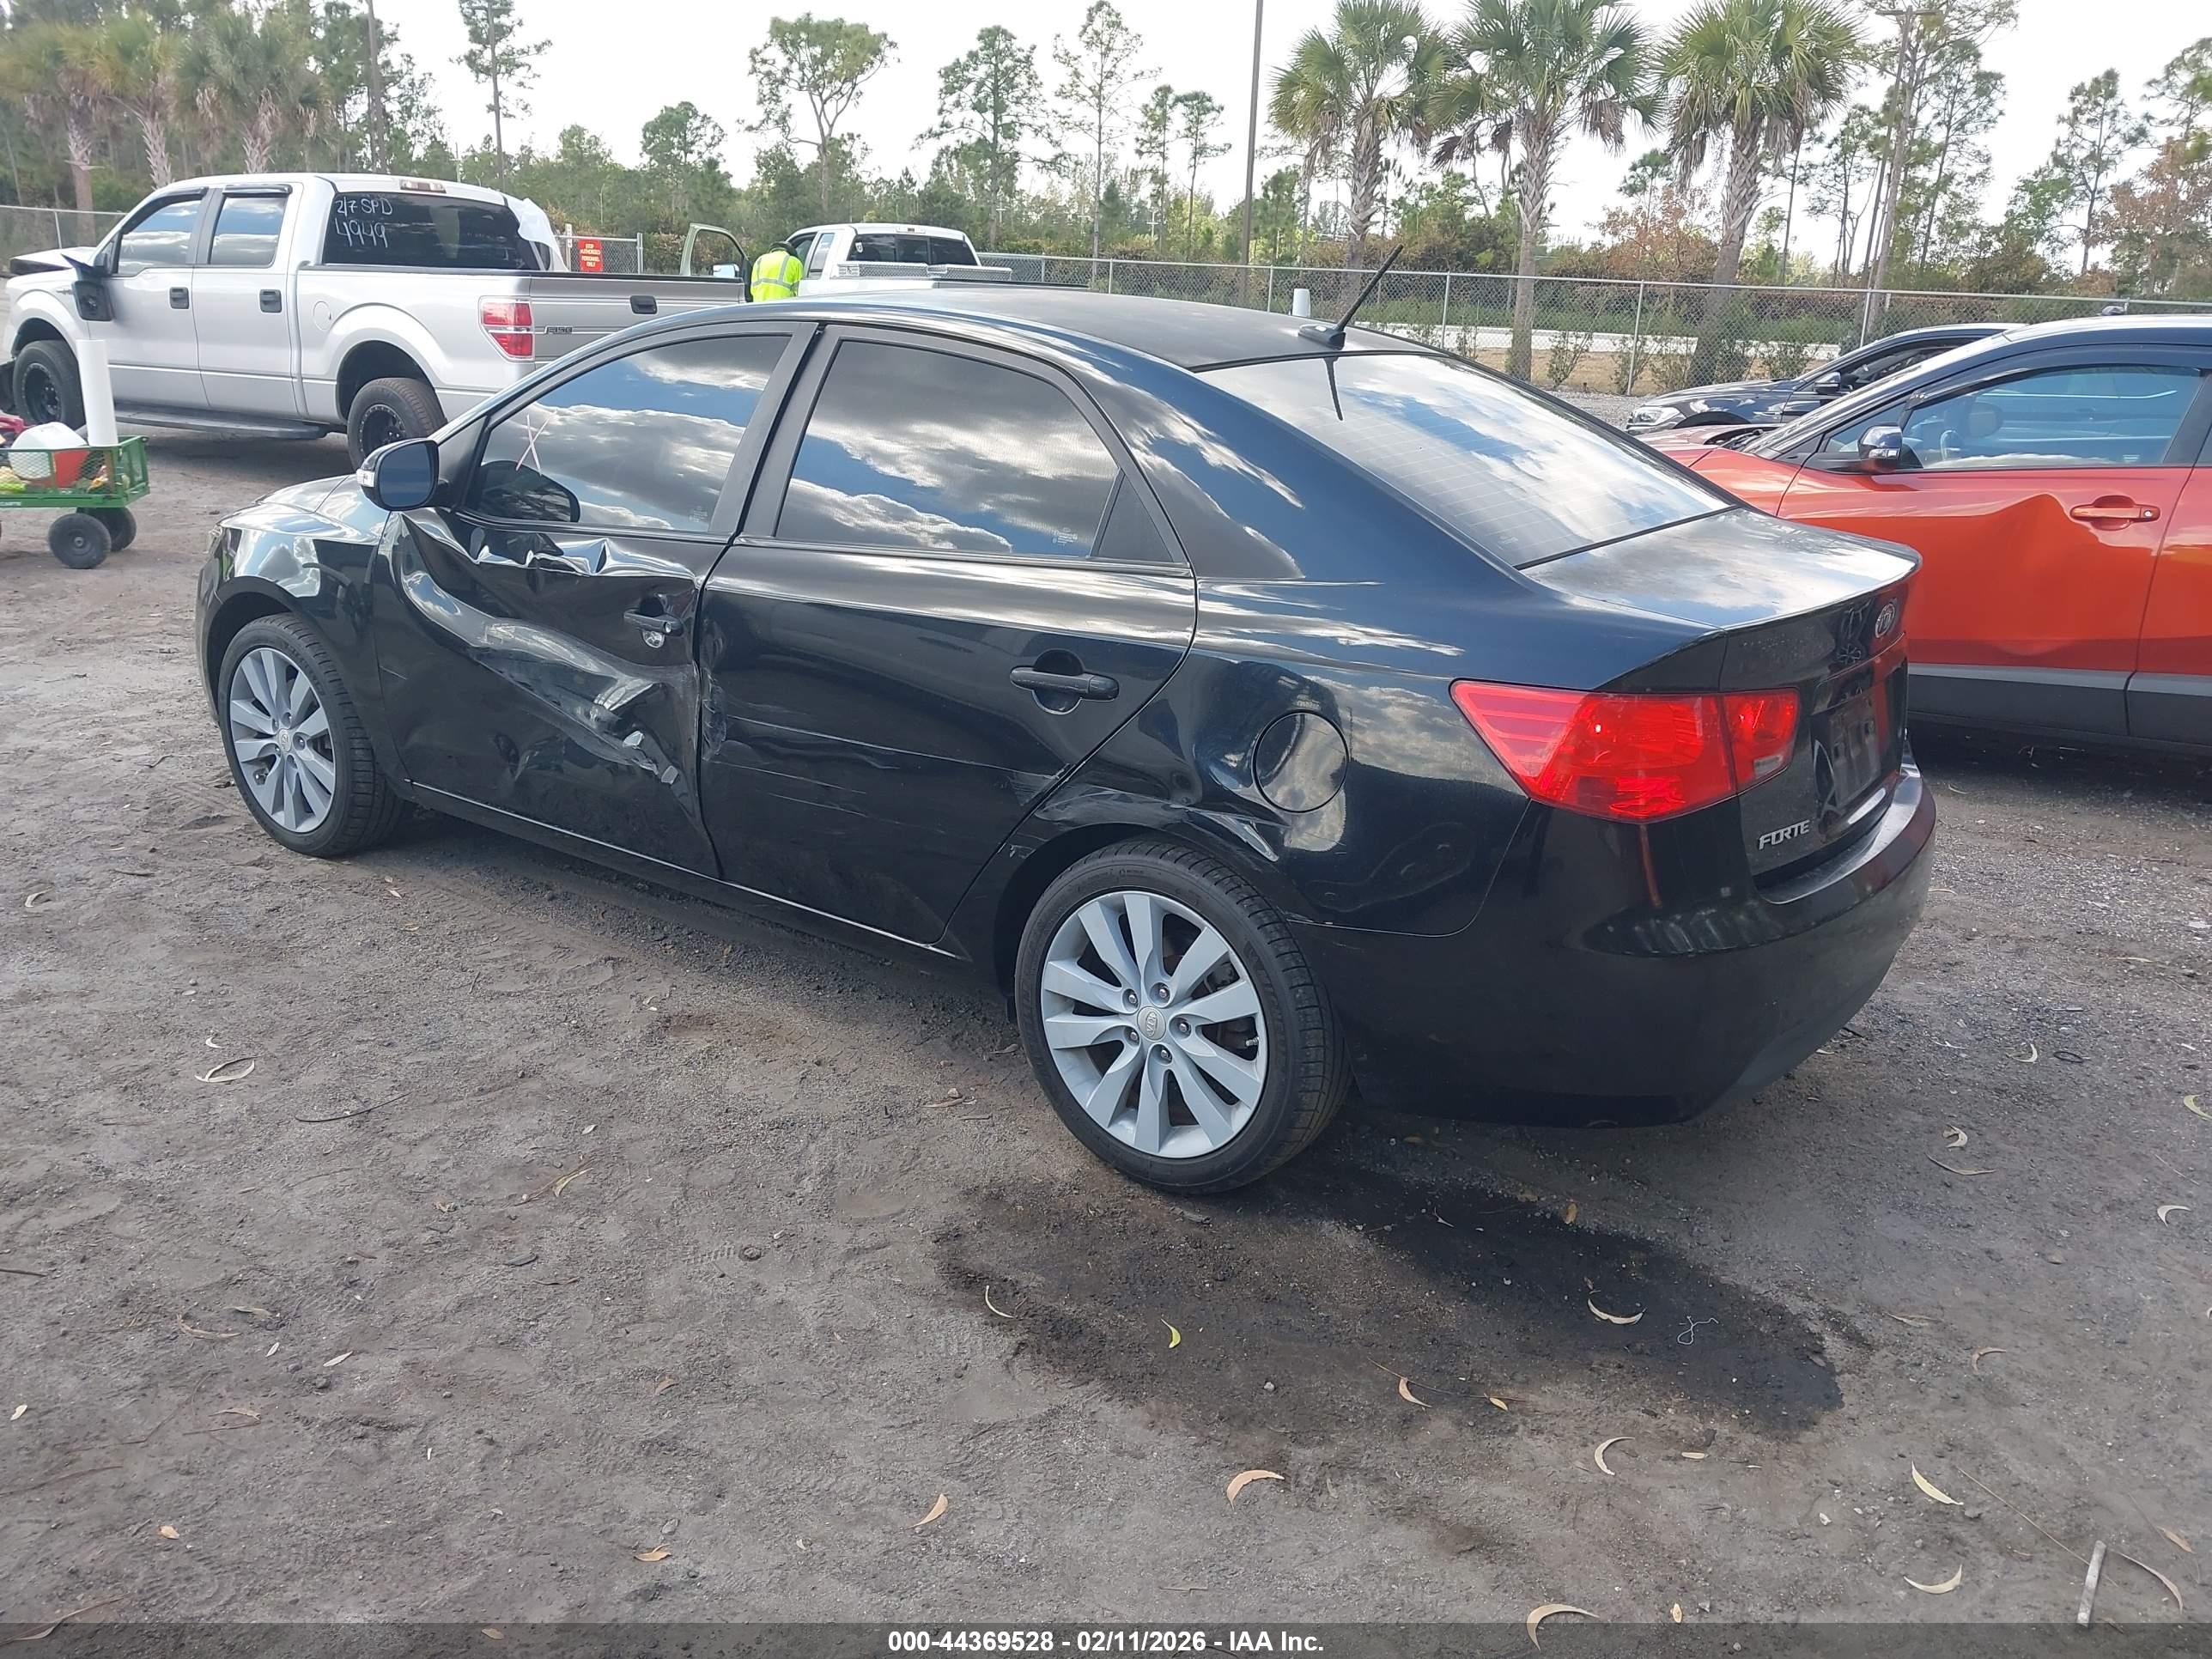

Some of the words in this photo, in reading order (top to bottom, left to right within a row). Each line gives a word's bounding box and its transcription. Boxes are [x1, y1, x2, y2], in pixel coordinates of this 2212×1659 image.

[361, 198, 392, 215] SPD
[335, 217, 388, 248] 4949
[1759, 819, 1810, 850] FORTE
